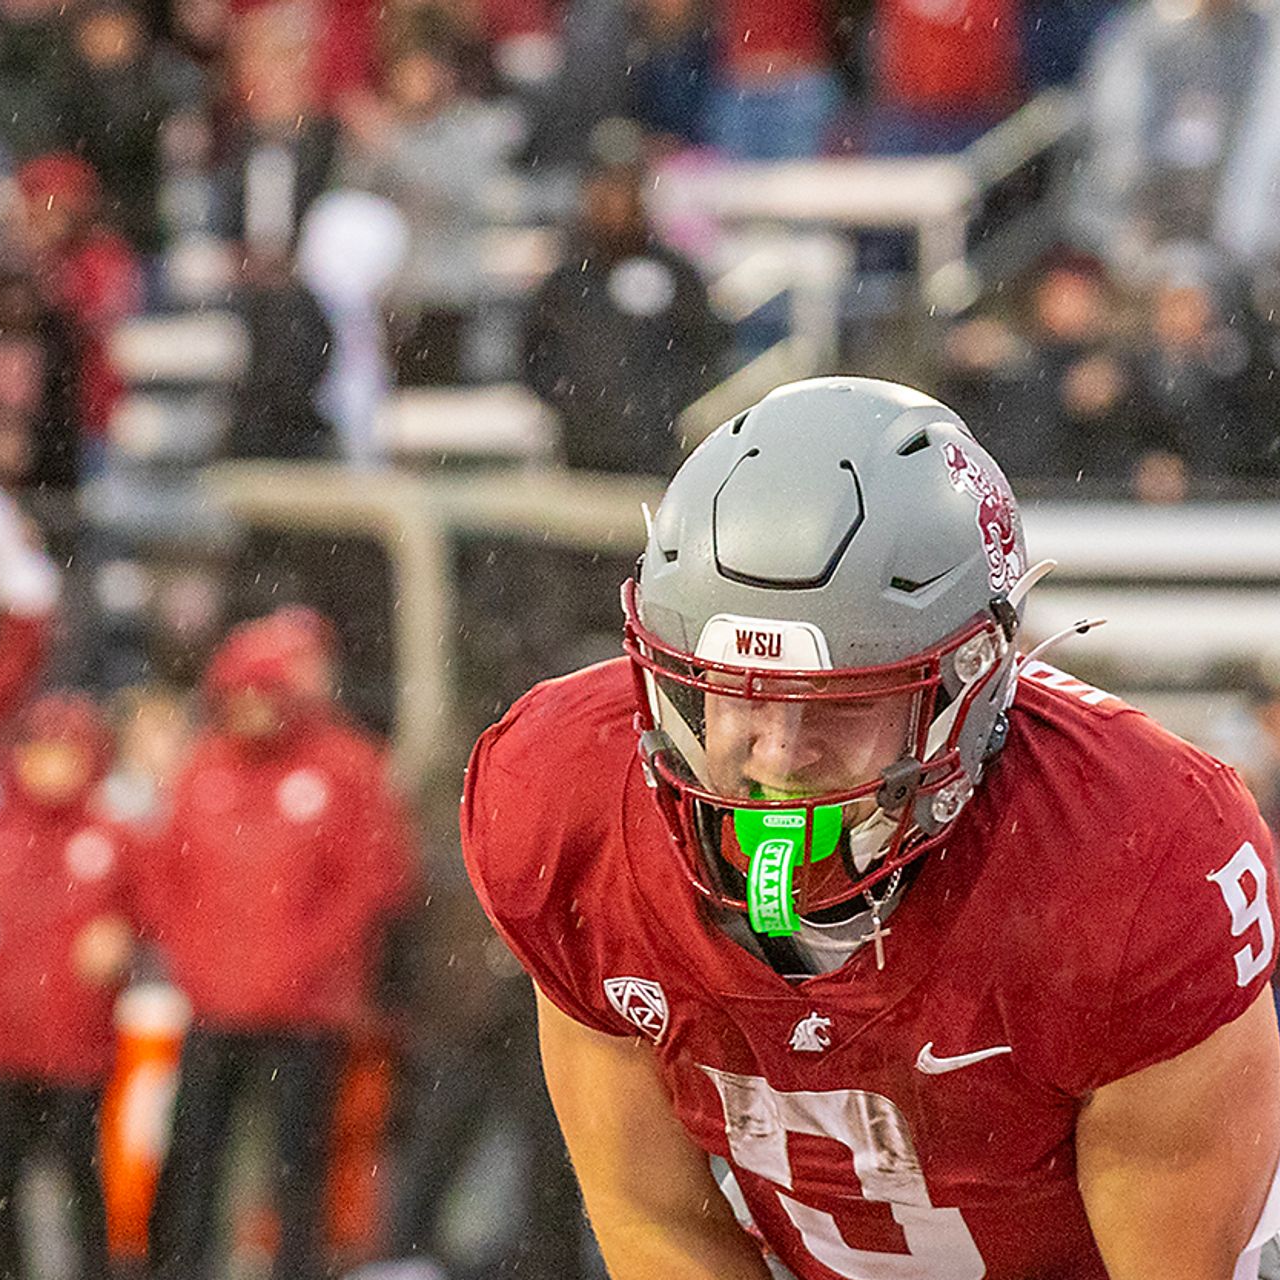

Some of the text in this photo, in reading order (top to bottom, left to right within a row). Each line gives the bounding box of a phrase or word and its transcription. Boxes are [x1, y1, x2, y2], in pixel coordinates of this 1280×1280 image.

[735, 628, 782, 658] WSU
[1206, 841, 1275, 987] 9
[629, 1006, 661, 1029] 12
